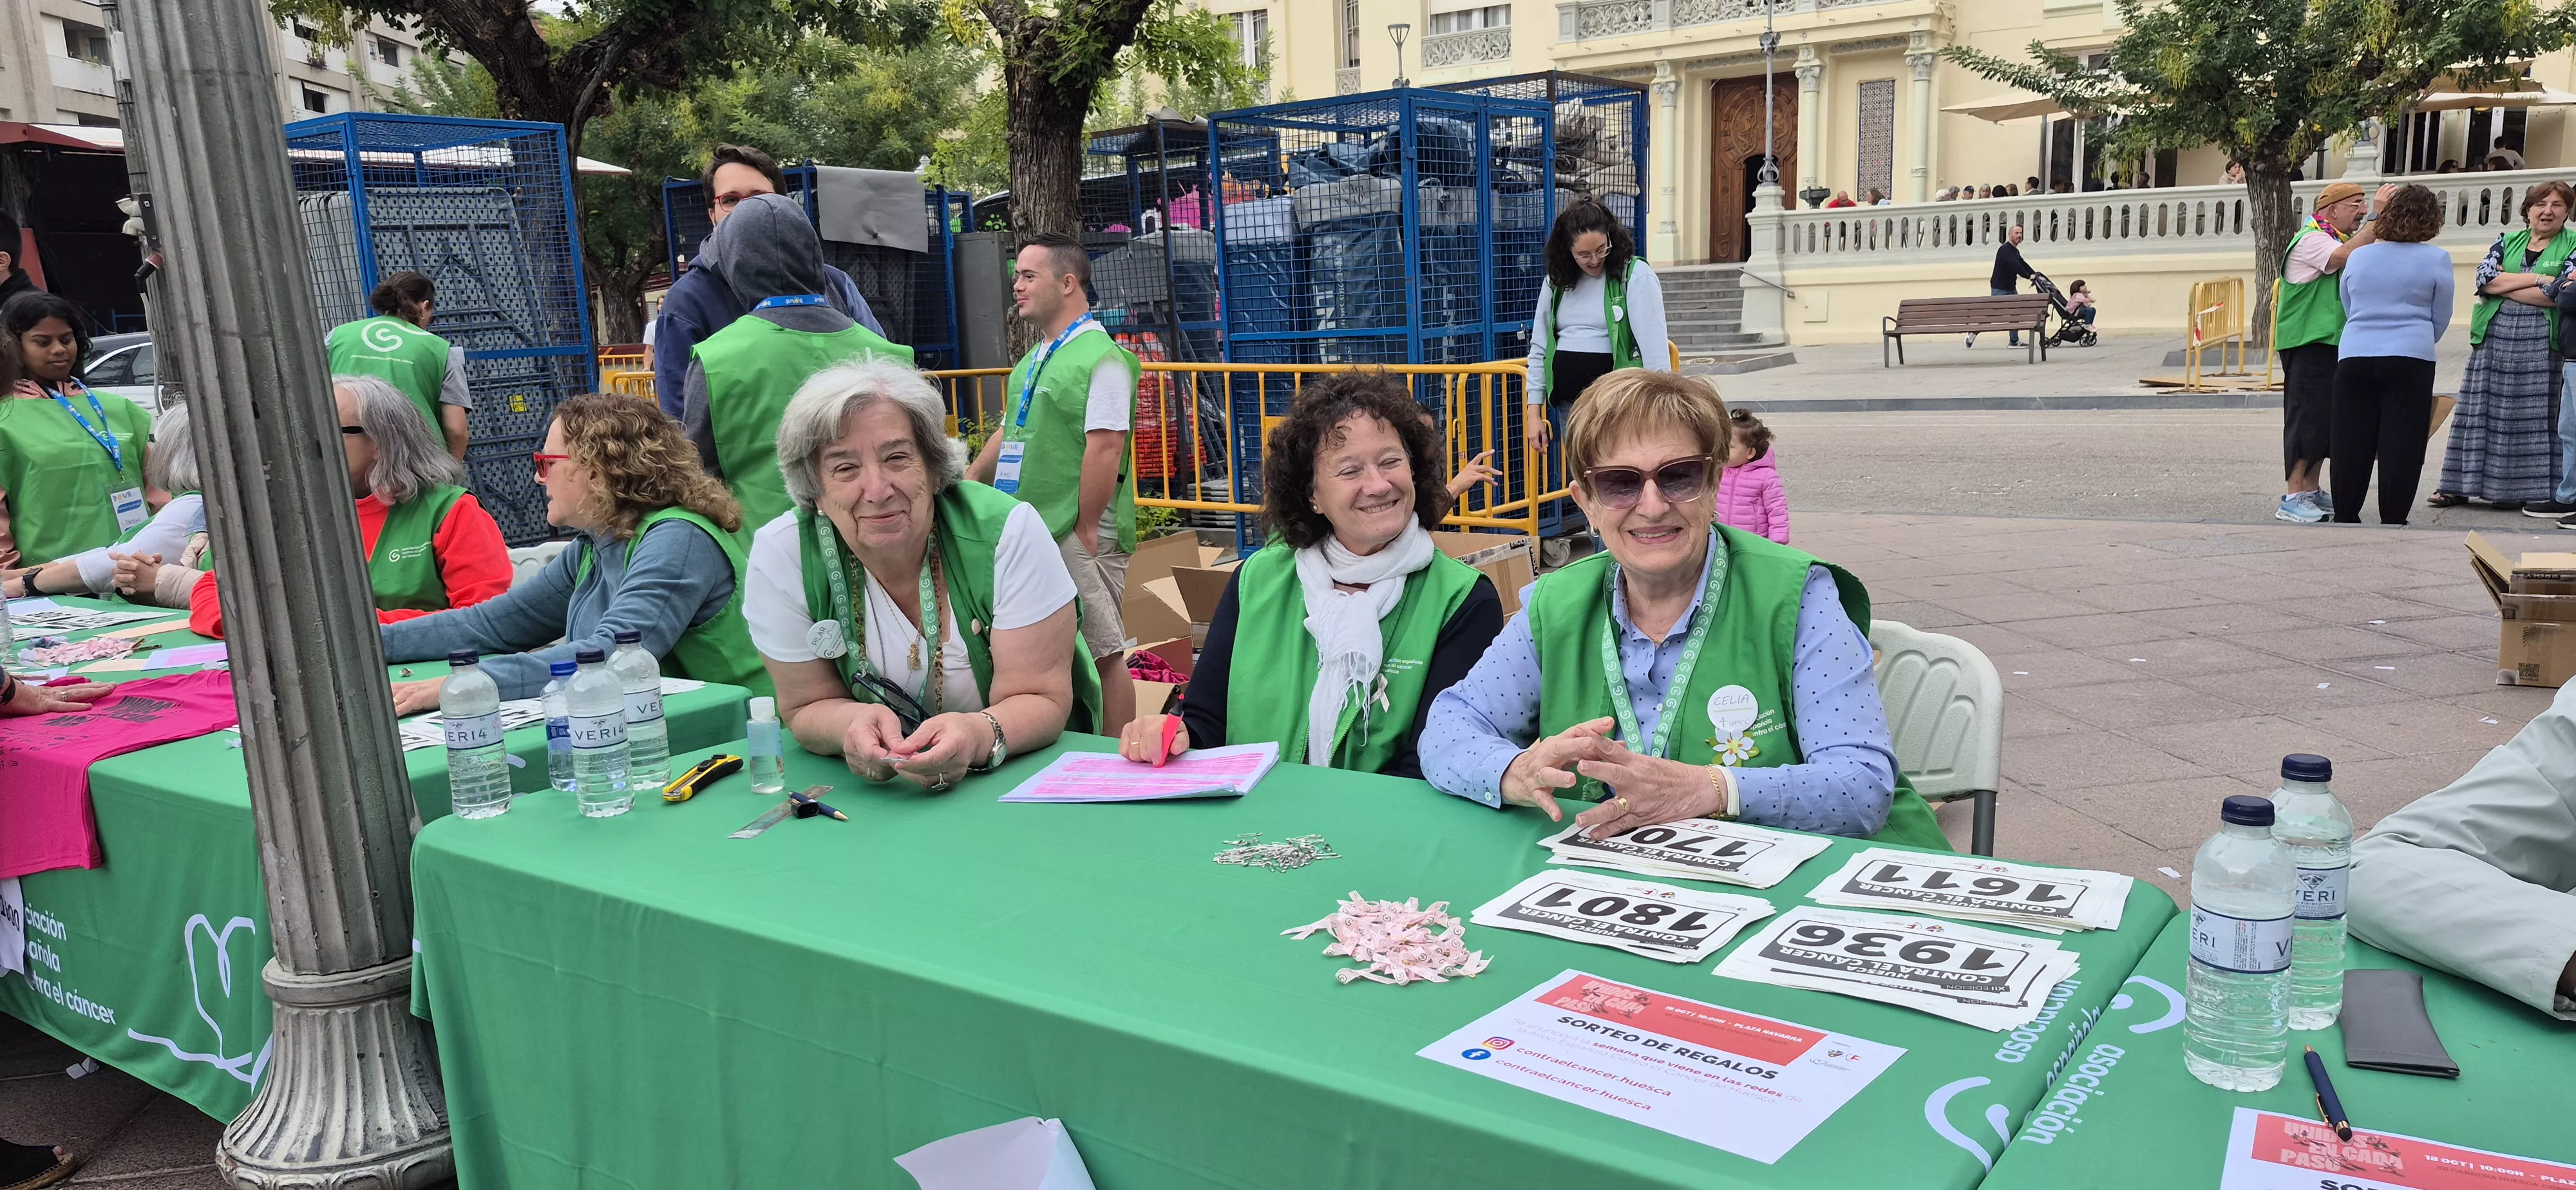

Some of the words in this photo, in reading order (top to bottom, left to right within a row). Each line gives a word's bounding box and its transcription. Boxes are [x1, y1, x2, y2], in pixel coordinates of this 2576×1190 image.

[811, 627, 827, 646] PILAR
[1714, 694, 1749, 706] CELIA
[1577, 836, 1642, 852] CÁNCER
[1621, 849, 1667, 861] HUESCA
[1662, 852, 1731, 867] CONTRA
[1859, 882, 1939, 899] CÁNCER
[1871, 864, 2067, 902] 1611
[1944, 894, 1965, 903] EL
[1971, 898, 2057, 913] CONTRA
[1518, 906, 1586, 925] CÁNCER
[1535, 887, 1708, 932] 1801
[1567, 924, 1619, 938] HUESCA
[1592, 921, 1611, 929] EL
[1613, 925, 1689, 943] CONTRA
[1779, 946, 1864, 966] CÁNCER
[1787, 924, 2005, 971] 1936
[1846, 965, 1909, 980] HUESCA
[1870, 959, 1891, 970] EL
[1899, 964, 1993, 983] CONTRA
[53, 981, 64, 1006] el
[66, 988, 117, 1025] cáncer
[1697, 1014, 1726, 1025] 10:00H
[1733, 1023, 1762, 1034] PLAZA
[1761, 1028, 1803, 1043] NAVARRA
[1557, 1016, 1640, 1043] SORTEO
[1641, 1039, 1674, 1052] DE
[1672, 1046, 1779, 1080] REGALOS
[1517, 1047, 1672, 1097] contraelcancer.huesca
[1592, 1041, 1640, 1059] semana
[1640, 1054, 1666, 1065] que
[1667, 1061, 1702, 1076] viene
[1703, 1072, 1721, 1081] en
[1722, 1076, 1743, 1086] las
[1745, 1082, 1784, 1098] redes
[1785, 1094, 1804, 1104] de
[1610, 1052, 1649, 1068] Contra
[1709, 1081, 1727, 1090] de
[1495, 1059, 1652, 1111] contraelcancer.huesca
[2020, 1043, 2125, 1145] asociación
[2280, 1148, 2341, 1171] PASO
[2309, 1143, 2338, 1159] EN
[2342, 1146, 2403, 1170] CADA
[2441, 1158, 2467, 1168] OCT
[2479, 1164, 2524, 1177] 10:00H
[2451, 1167, 2497, 1181] CARRERA
[2499, 1176, 2539, 1187] HUESCA
